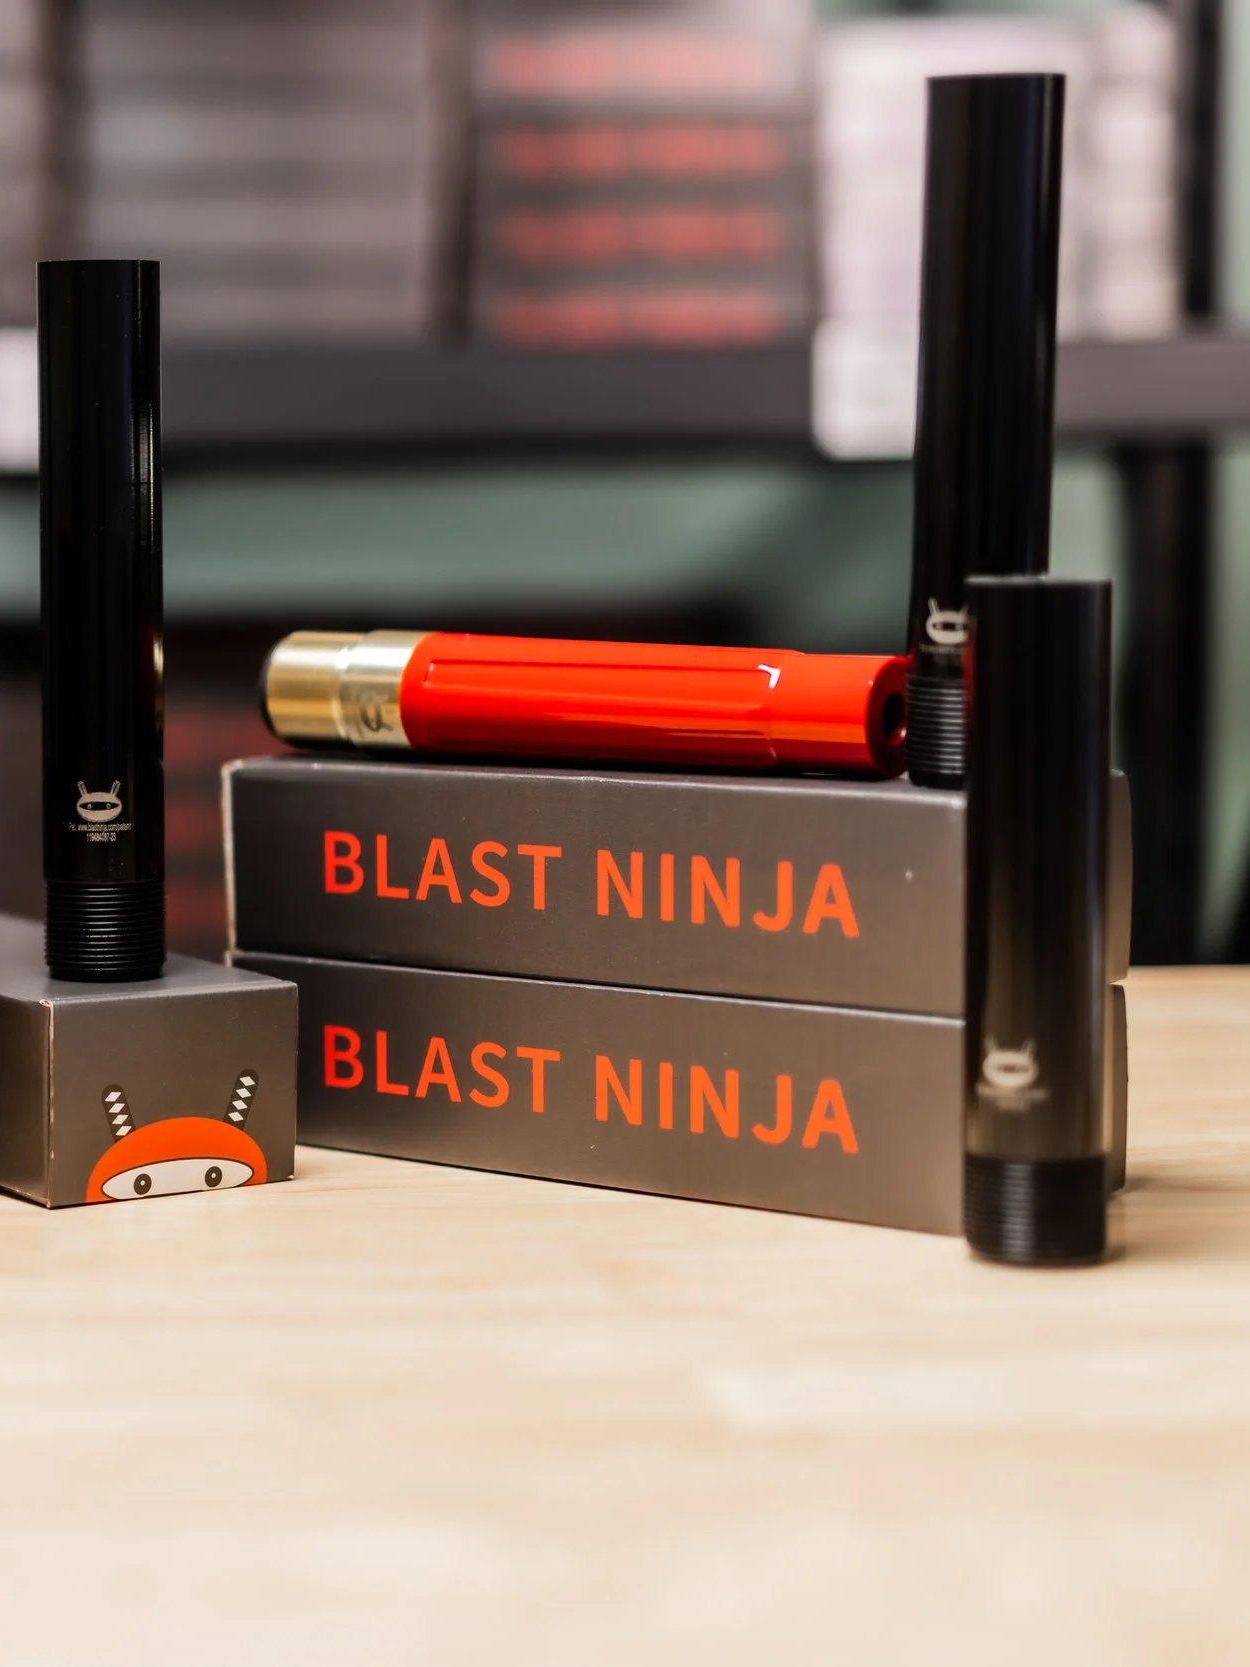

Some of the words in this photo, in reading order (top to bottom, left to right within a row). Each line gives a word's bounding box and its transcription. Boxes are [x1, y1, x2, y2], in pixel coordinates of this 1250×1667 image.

[324, 830, 563, 911] BLAST
[596, 848, 861, 940] NINJA
[323, 1025, 562, 1114] BLAST
[594, 1054, 861, 1156] NINJA
